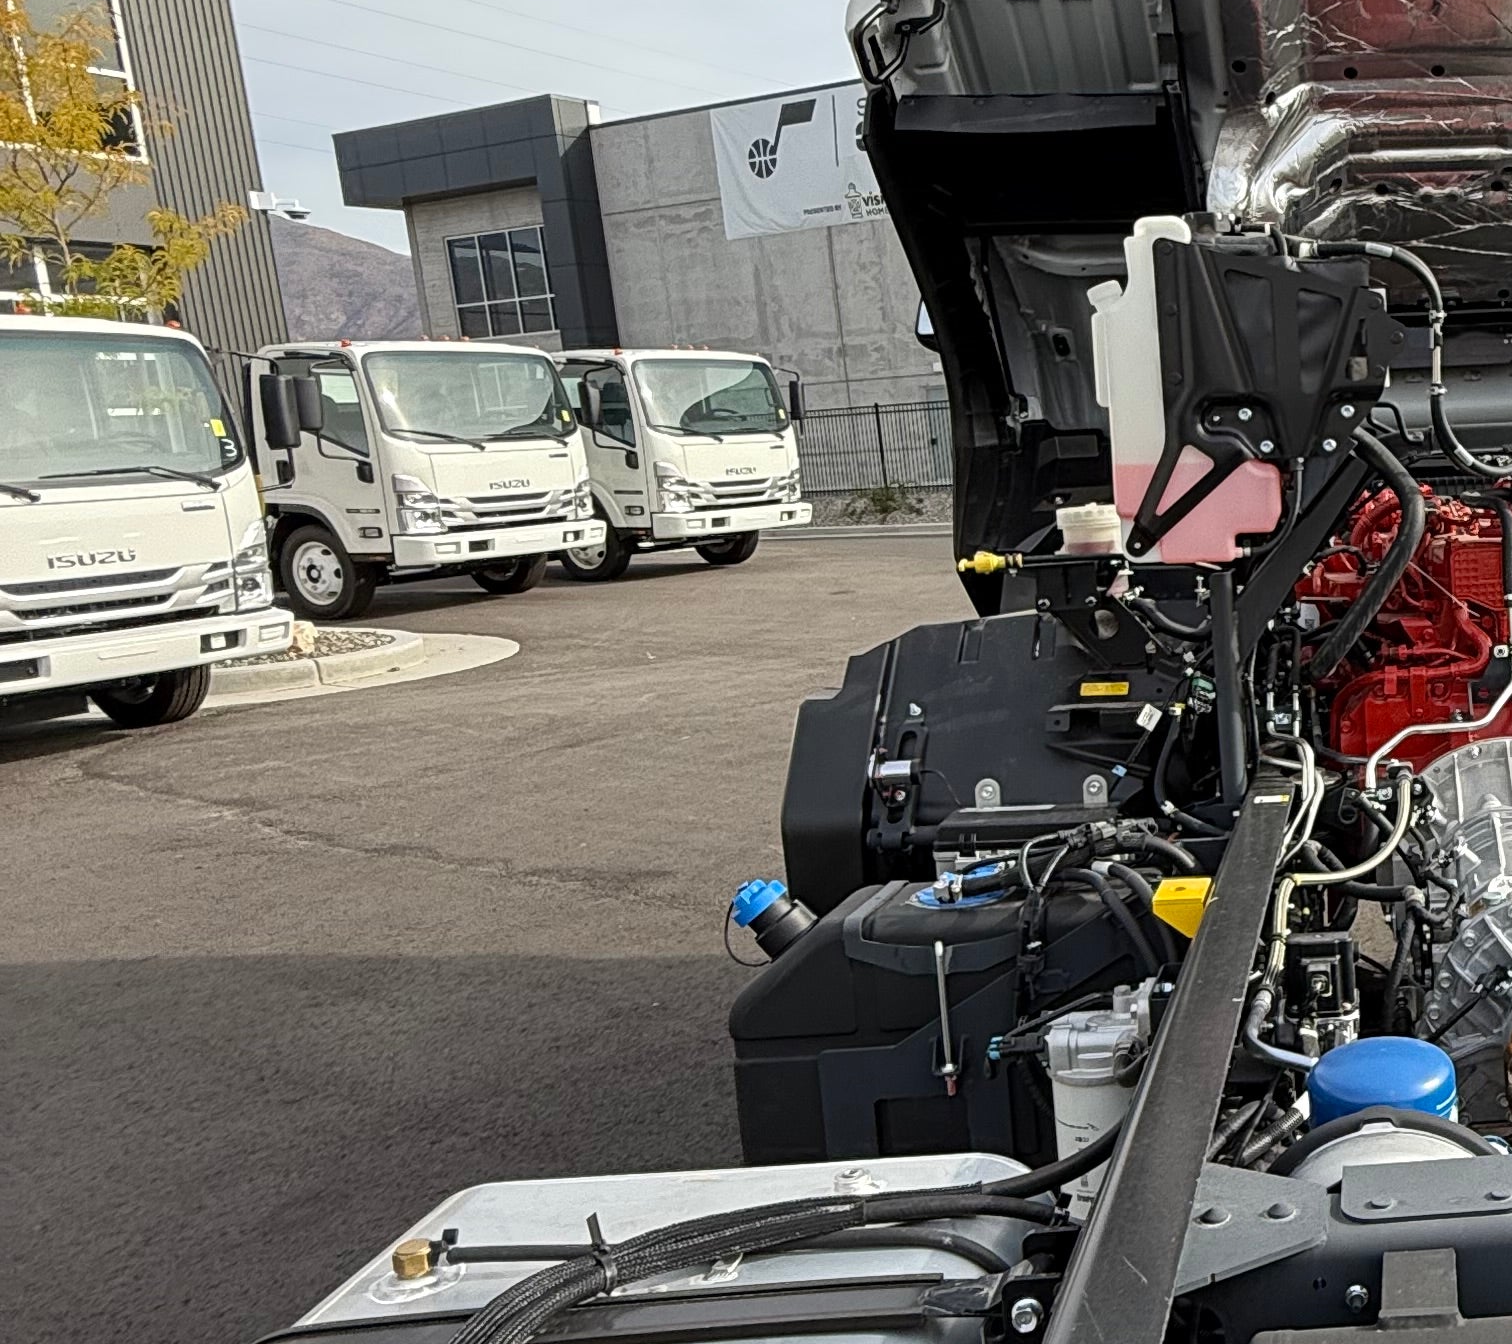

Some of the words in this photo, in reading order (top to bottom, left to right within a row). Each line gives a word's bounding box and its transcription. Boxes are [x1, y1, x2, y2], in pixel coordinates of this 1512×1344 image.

[220, 438, 238, 458] 3
[489, 479, 531, 490] ISUZU
[47, 548, 137, 570] ISUZU
